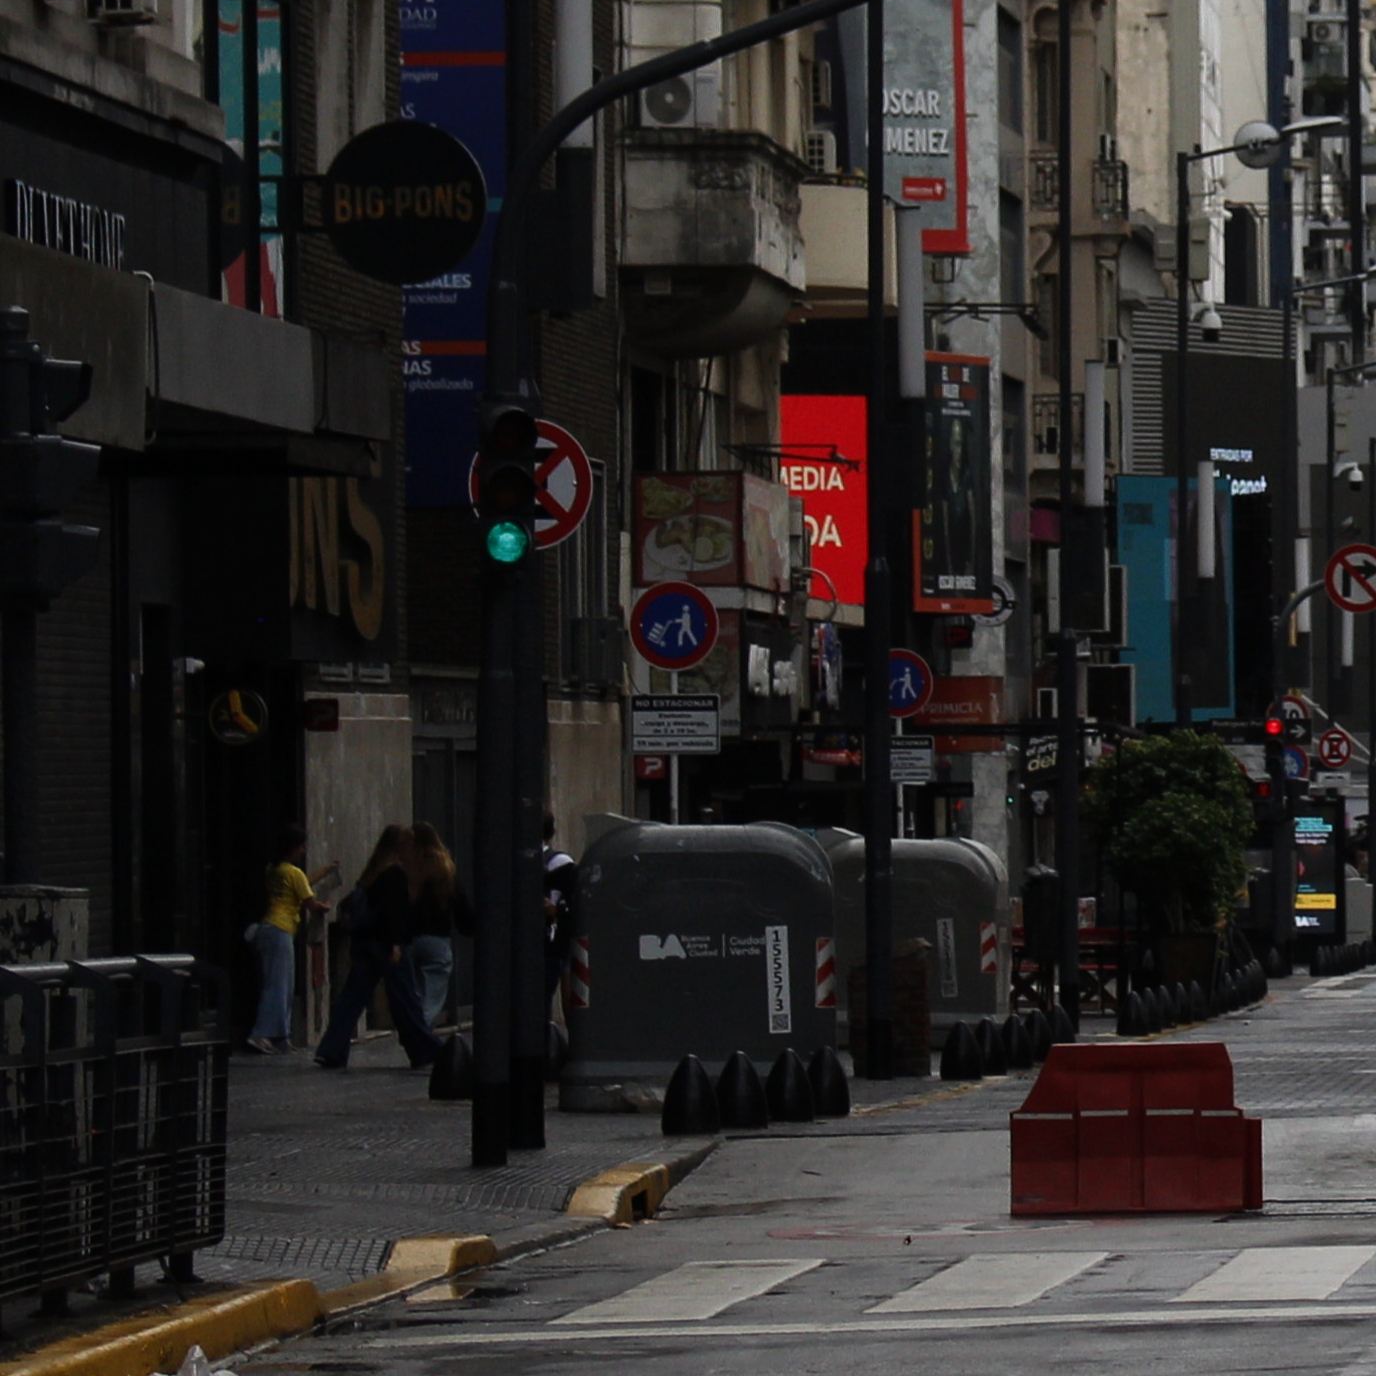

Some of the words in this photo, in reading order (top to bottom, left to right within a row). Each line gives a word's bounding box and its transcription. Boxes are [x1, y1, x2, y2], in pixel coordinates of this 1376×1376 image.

[653, 700, 713, 708] ESTACIONAR
[921, 702, 983, 714] PRIMICIA
[1027, 751, 1057, 773] del
[729, 936, 765, 946] Ciudad
[639, 934, 687, 960] BA
[729, 946, 761, 956] Verde
[688, 949, 718, 957] Ciudad
[773, 929, 784, 1012] 155573
